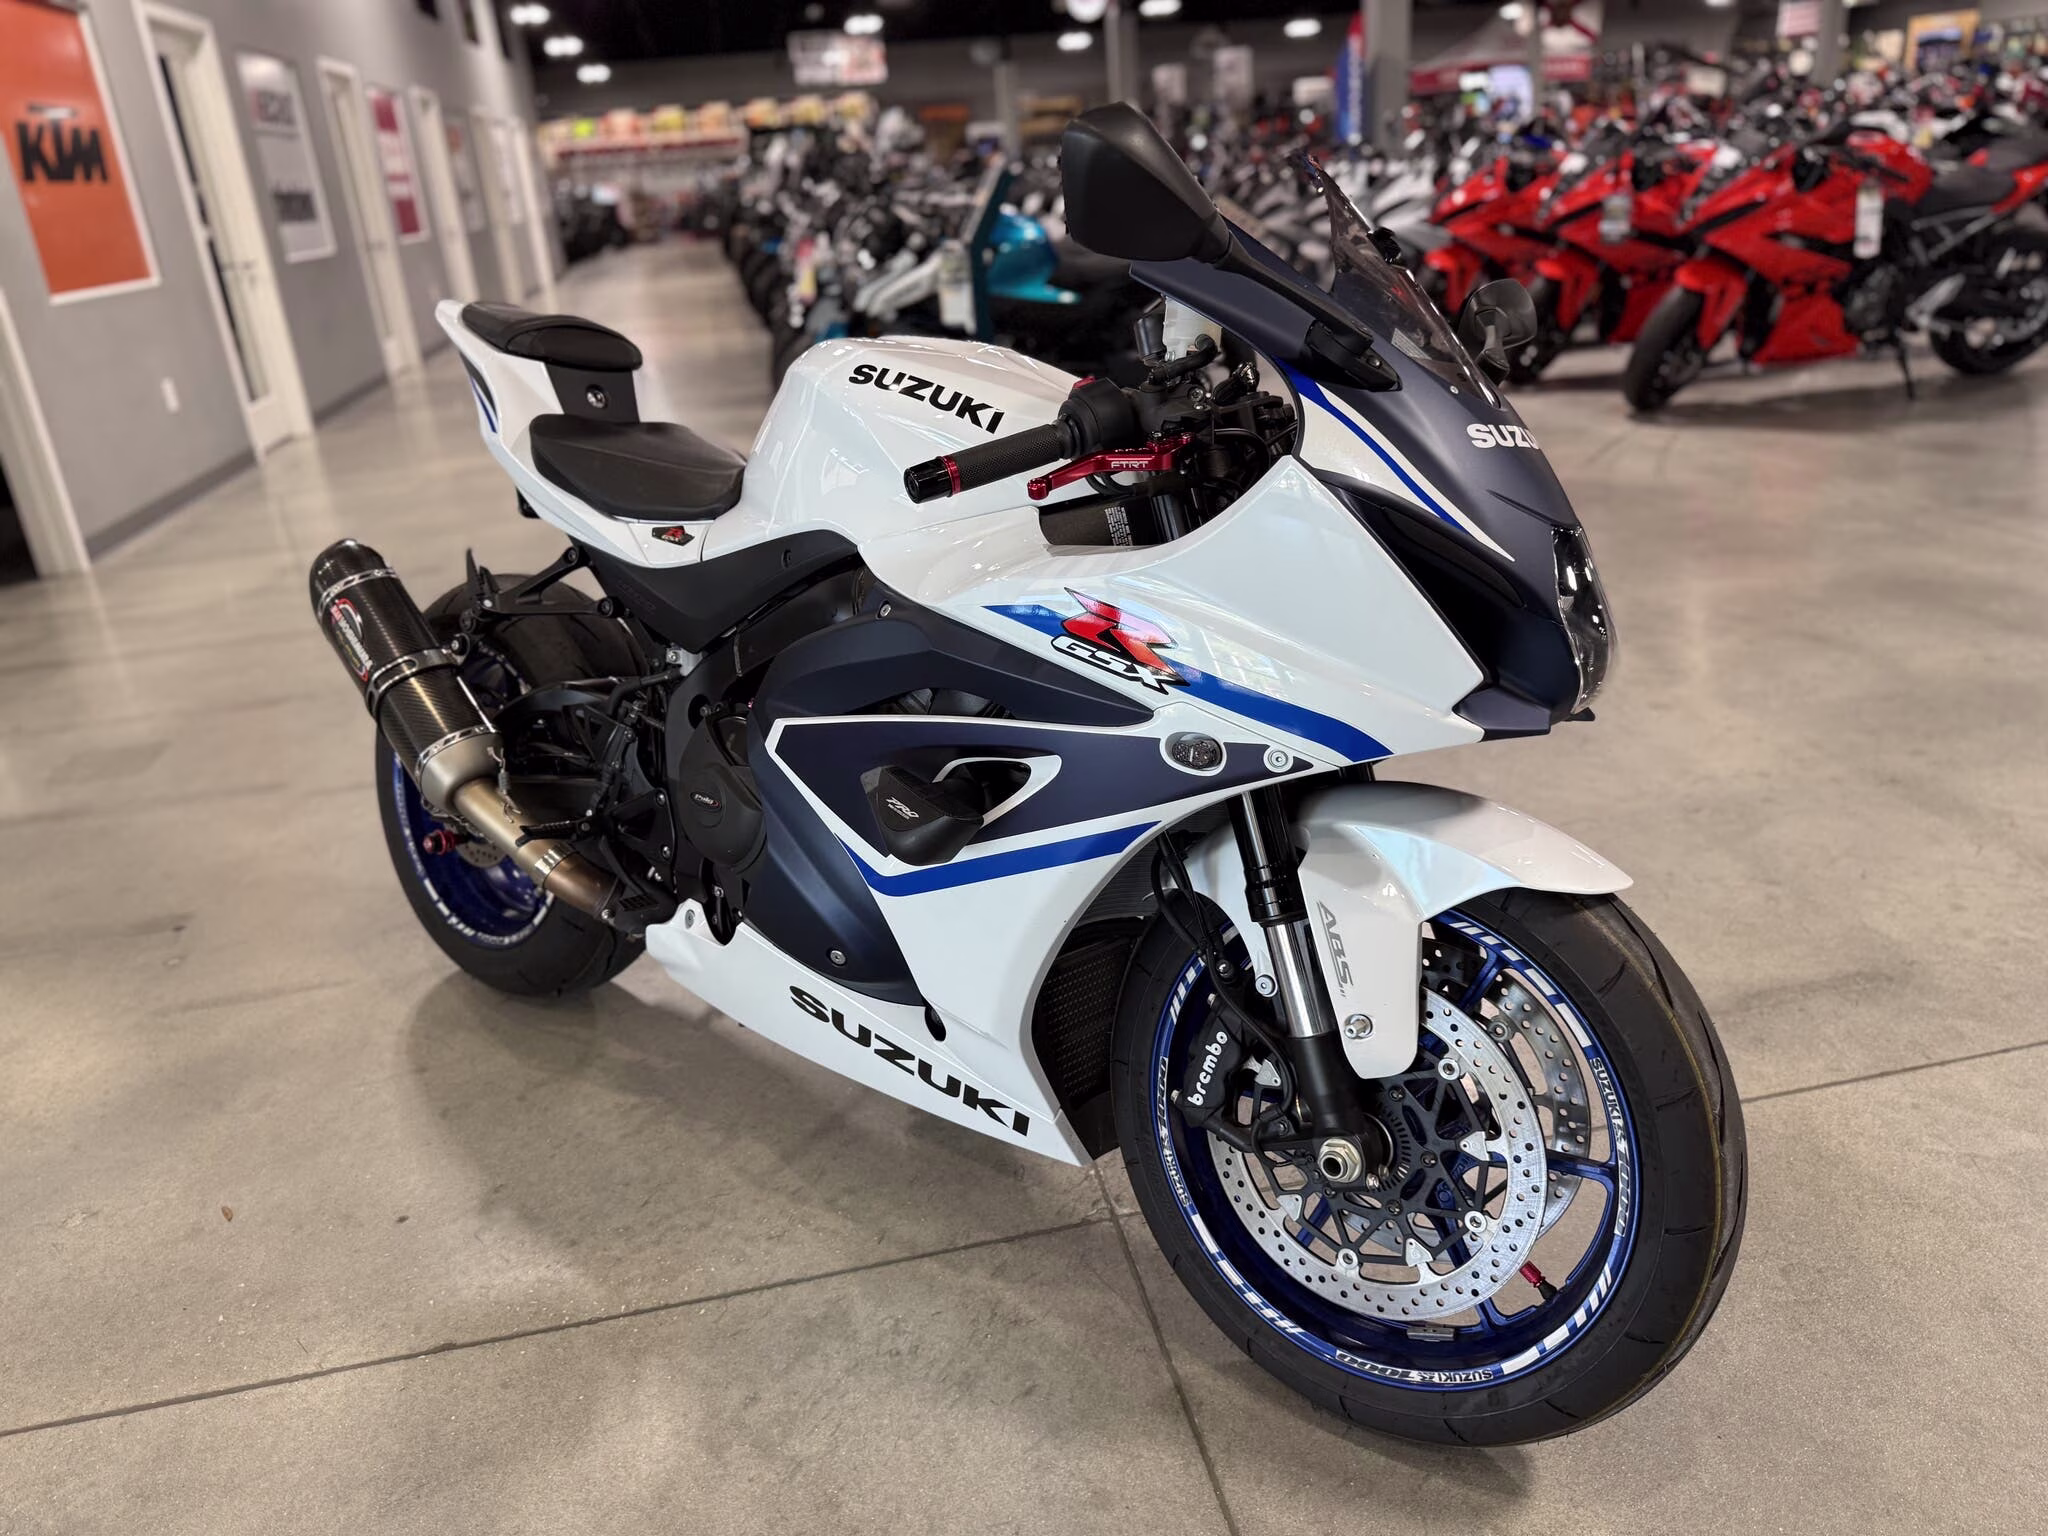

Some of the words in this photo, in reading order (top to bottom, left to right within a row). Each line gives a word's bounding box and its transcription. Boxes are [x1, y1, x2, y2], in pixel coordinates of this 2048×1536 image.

[16, 104, 109, 183] KTM
[848, 364, 1005, 434] SUZUKI
[1051, 634, 1172, 692] GSX
[886, 796, 920, 818] PRO
[1318, 901, 1354, 987] ABS
[790, 985, 1030, 1137] SUZUKI
[1187, 1031, 1228, 1106] brembo
[1591, 1058, 1623, 1121] SUZUKI
[1337, 1352, 1415, 1380] 1000
[1438, 1368, 1494, 1383] SUZUKI
